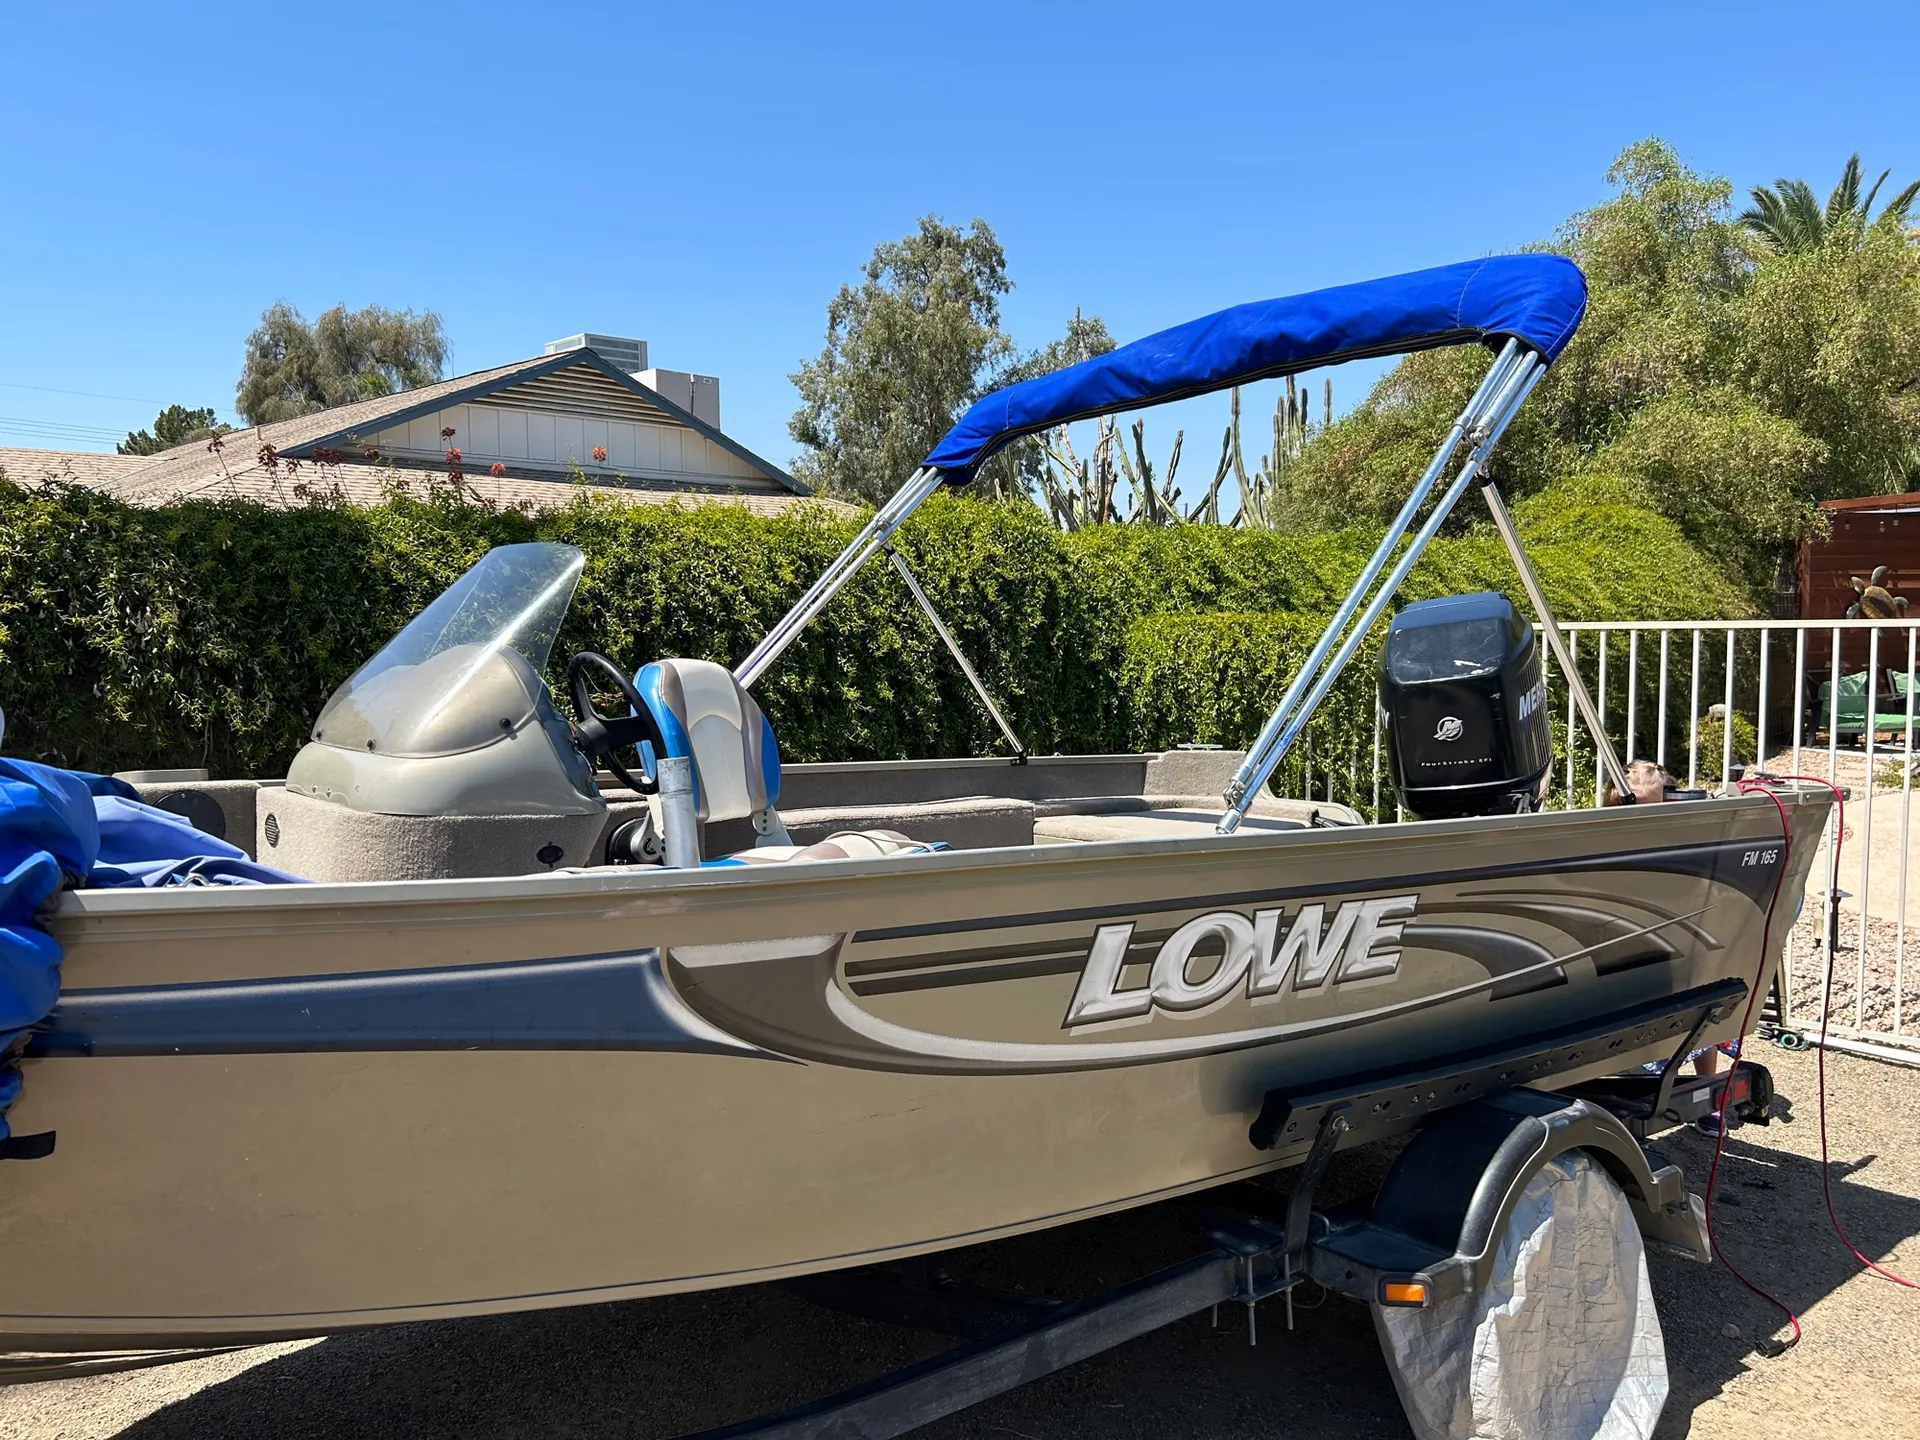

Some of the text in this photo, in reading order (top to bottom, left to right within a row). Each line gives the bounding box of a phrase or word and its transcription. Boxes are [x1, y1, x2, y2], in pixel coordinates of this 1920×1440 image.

[1741, 849, 1778, 867] FM 165
[1061, 893, 1420, 1030] LOWE
